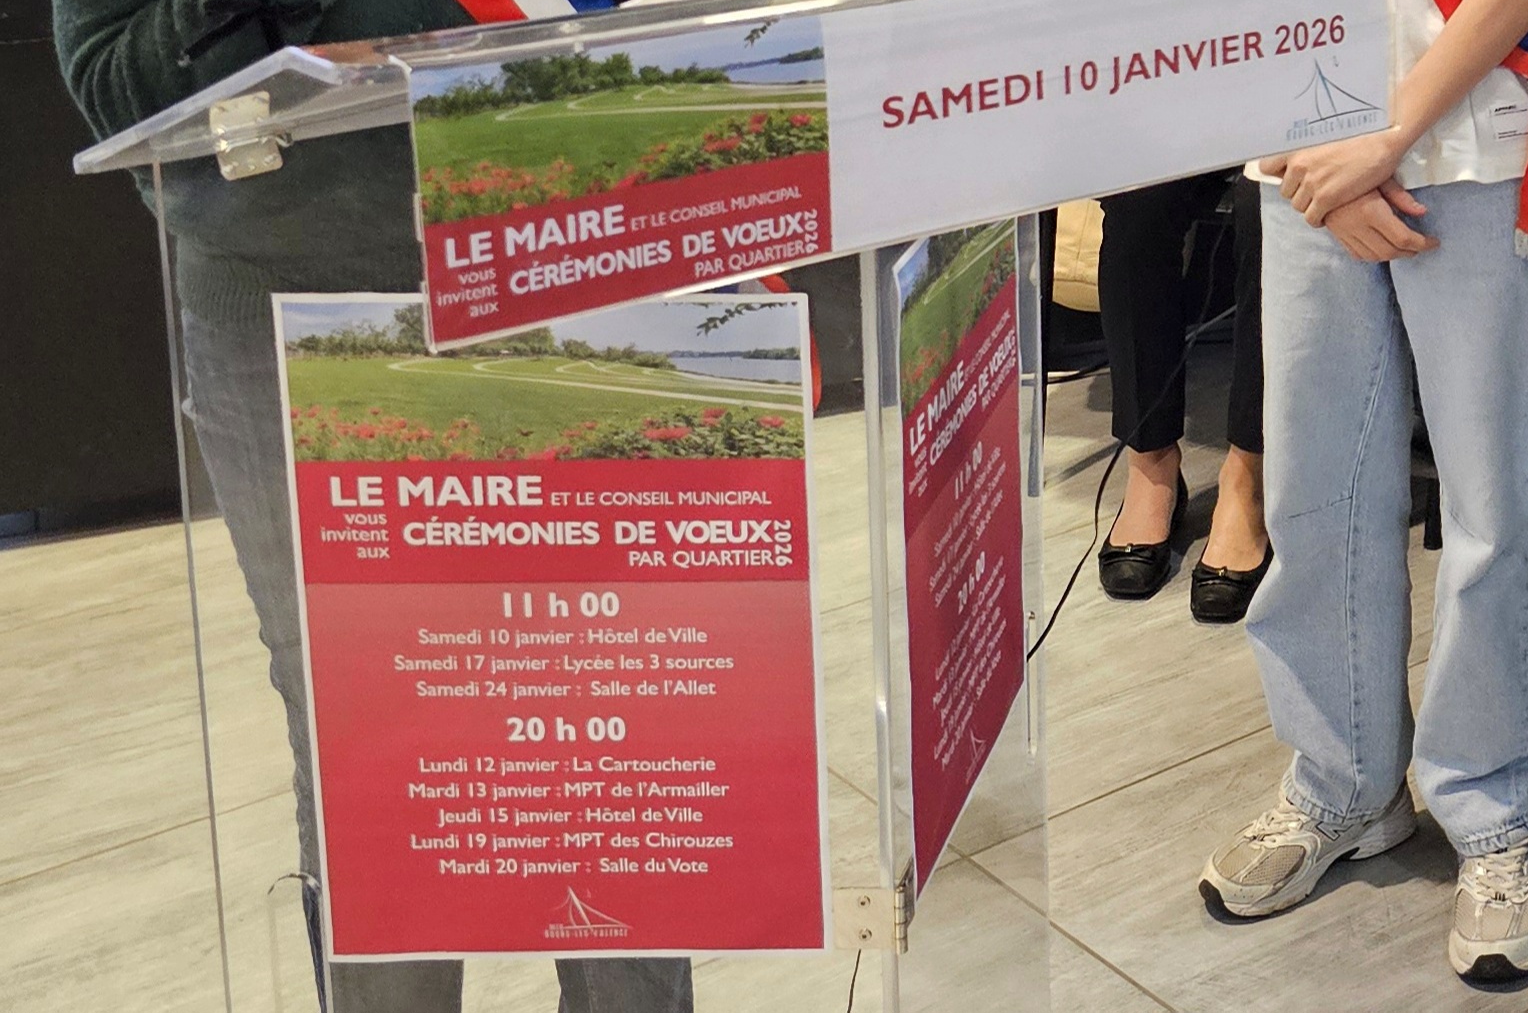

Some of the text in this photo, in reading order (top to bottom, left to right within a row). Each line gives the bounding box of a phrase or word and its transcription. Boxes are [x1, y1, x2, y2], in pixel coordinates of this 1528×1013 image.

[881, 15, 1346, 128] SAMEDI 10 JANVIER 2026
[445, 186, 802, 268] LE MAIRE ET LE CONSEIL MUNICIPAL
[802, 209, 819, 254] 2026
[509, 240, 672, 296] CÉRÉMONIES
[683, 231, 716, 259] DE
[694, 240, 805, 279] PAR QUARTIER
[458, 269, 496, 285] vous
[436, 285, 498, 307] invitent
[470, 303, 499, 318] aux
[909, 411, 926, 457] LE
[927, 360, 965, 431] MAIRE
[330, 475, 772, 506] LE MAIRE ET LE CONSEIL MUNICIPAL
[344, 513, 388, 525] vous
[321, 526, 389, 542] invitent
[403, 515, 600, 546] CÉRÉMONIES
[614, 521, 657, 545] DE
[356, 546, 390, 559] aux
[774, 519, 793, 567] 2026
[628, 549, 774, 569] PAR QUARTIER
[503, 591, 620, 618] 11 h 00
[418, 628, 482, 645] Samedi
[490, 628, 510, 644] 10
[515, 629, 574, 649] janvier
[588, 627, 639, 644] Hôtel
[394, 654, 458, 671] Samedi
[466, 654, 486, 670] 17
[490, 655, 549, 675] janvier
[563, 654, 615, 675] Lycée
[620, 654, 644, 670] les
[649, 653, 660, 670] 3
[665, 657, 734, 669] sources
[416, 680, 480, 697] Samedi
[484, 680, 508, 697] 24
[513, 681, 572, 701] janvier
[590, 680, 631, 697] Salle
[636, 679, 659, 696] de
[506, 716, 626, 742] 20 h 00
[419, 757, 468, 773] Lundi
[476, 757, 496, 773] 12
[500, 757, 560, 777] janvier
[572, 756, 593, 772] La
[598, 756, 716, 772] Cartoucherie
[408, 782, 460, 799] Mardi
[468, 782, 487, 798] 13
[492, 783, 552, 802] janvier
[564, 781, 606, 798] MPT
[610, 781, 633, 797] de
[438, 807, 482, 828] Jeudi
[489, 807, 509, 823] 15
[514, 808, 573, 827] janvier
[585, 807, 636, 823] Hôtel
[410, 833, 460, 850] Lundi
[468, 832, 487, 849] 19
[492, 834, 551, 853] janvier
[563, 832, 605, 848] MPT
[610, 832, 640, 848] des
[645, 832, 734, 848] Chirouzes
[439, 858, 490, 875] Mardi
[494, 858, 518, 874] 20
[522, 859, 581, 878] janvier
[599, 857, 639, 873] Salle
